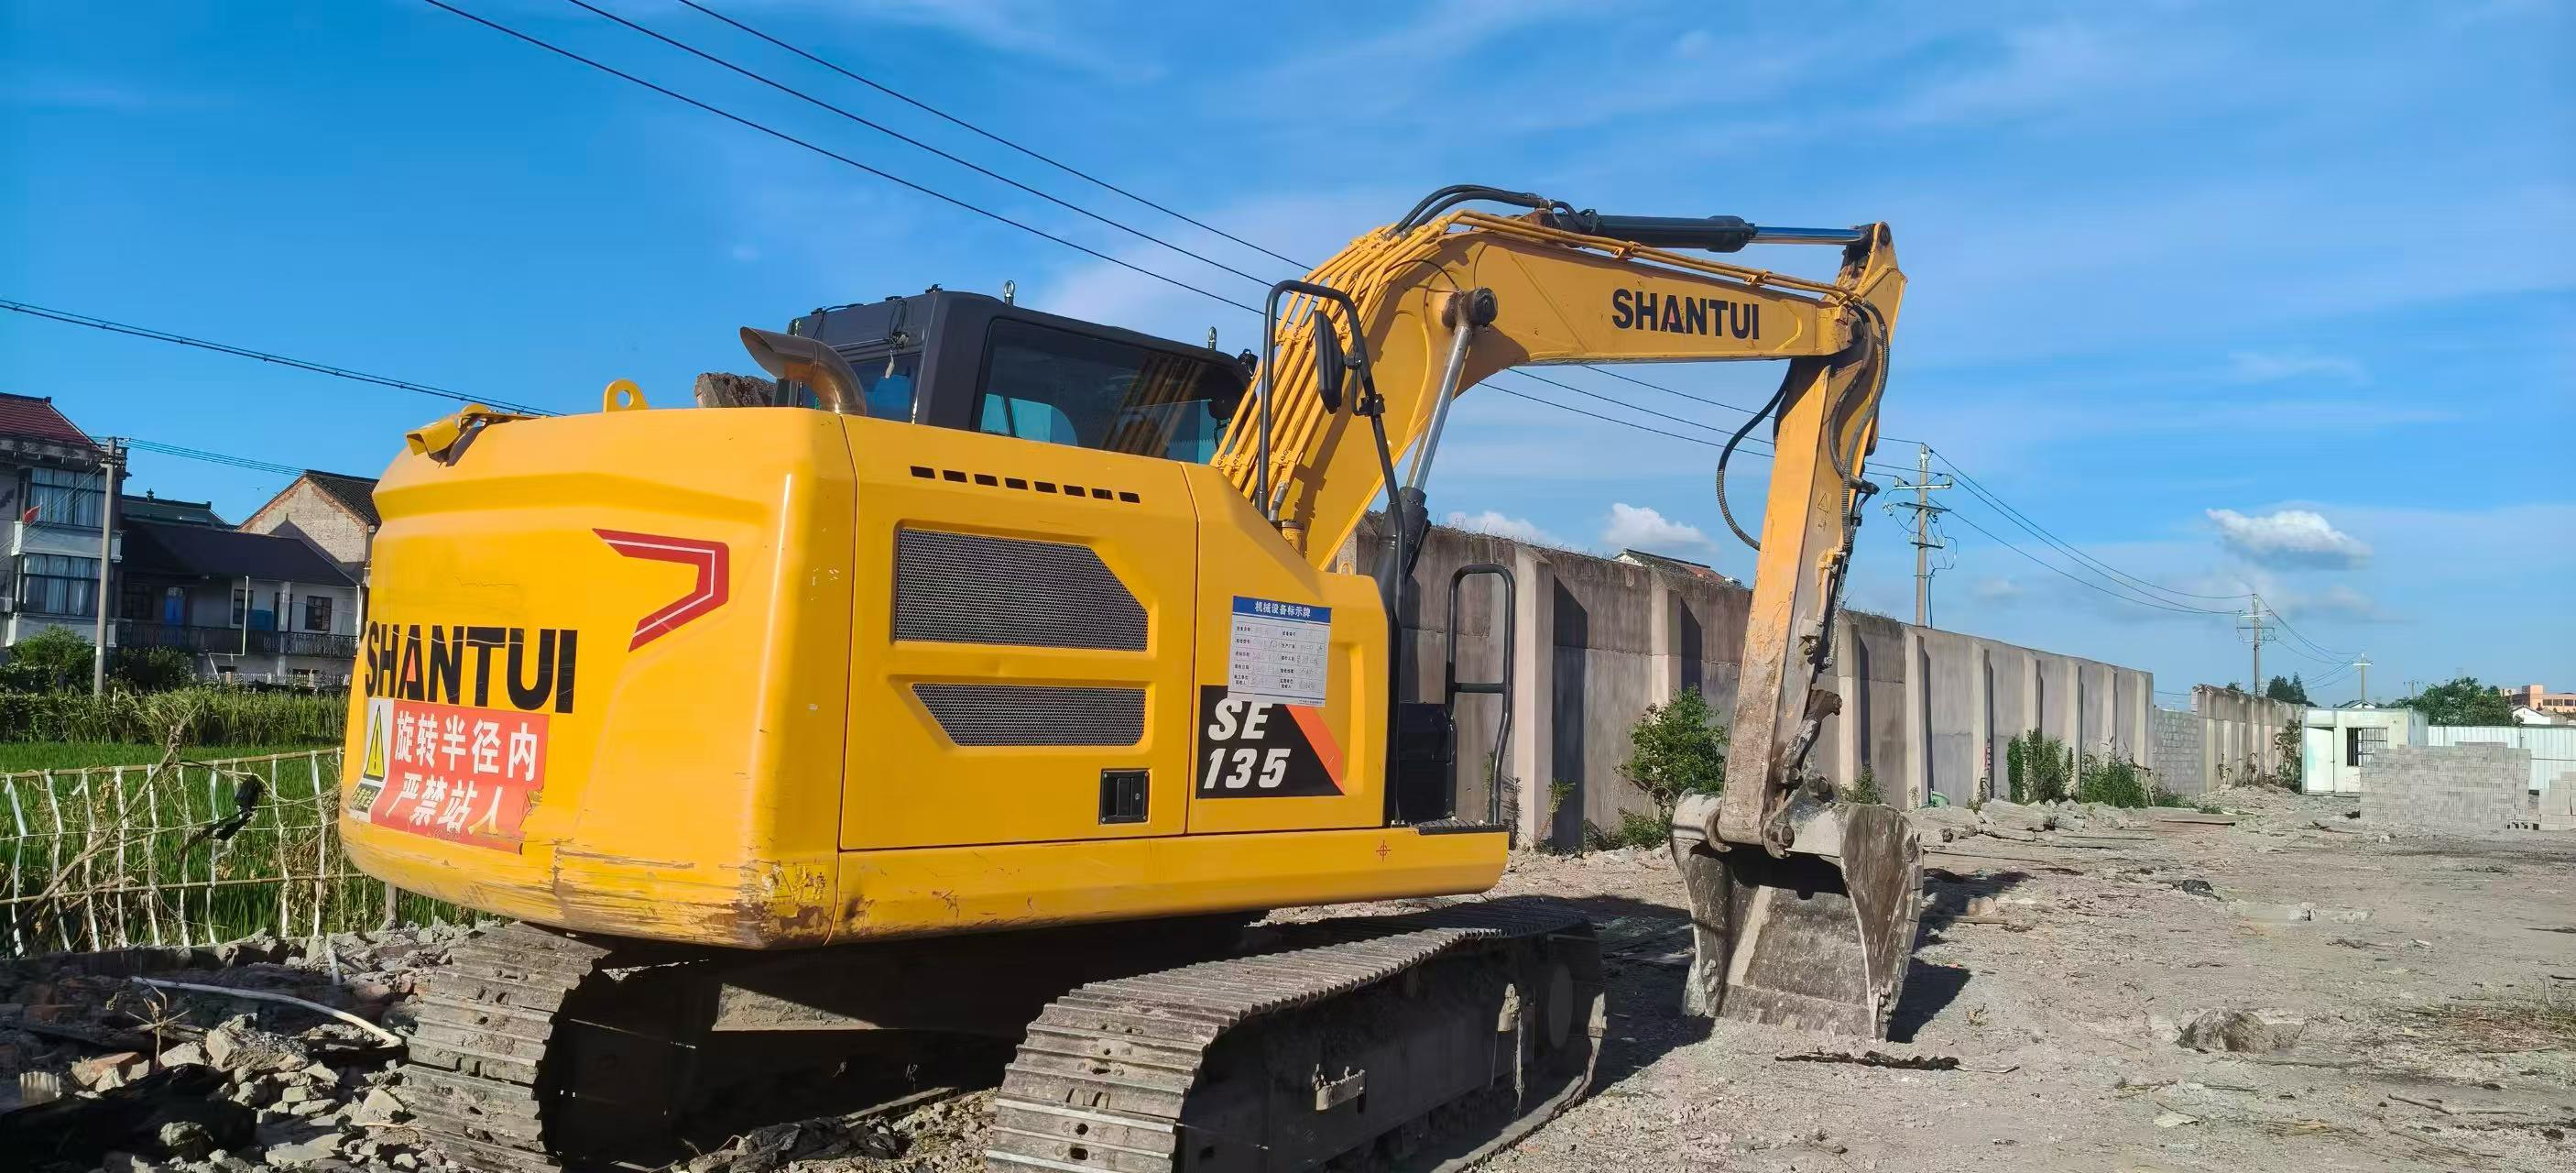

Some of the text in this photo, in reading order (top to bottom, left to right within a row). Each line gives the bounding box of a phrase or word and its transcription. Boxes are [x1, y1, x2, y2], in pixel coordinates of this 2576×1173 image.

[1612, 289, 1759, 340] SHANTUI
[1254, 600, 1311, 619] 机械设备标示牌
[365, 620, 578, 714] SHANTUI
[1208, 698, 1273, 740] SE
[395, 710, 538, 781] 旋转半径内
[1204, 748, 1292, 789] 135
[385, 772, 504, 835] 严禁站人
